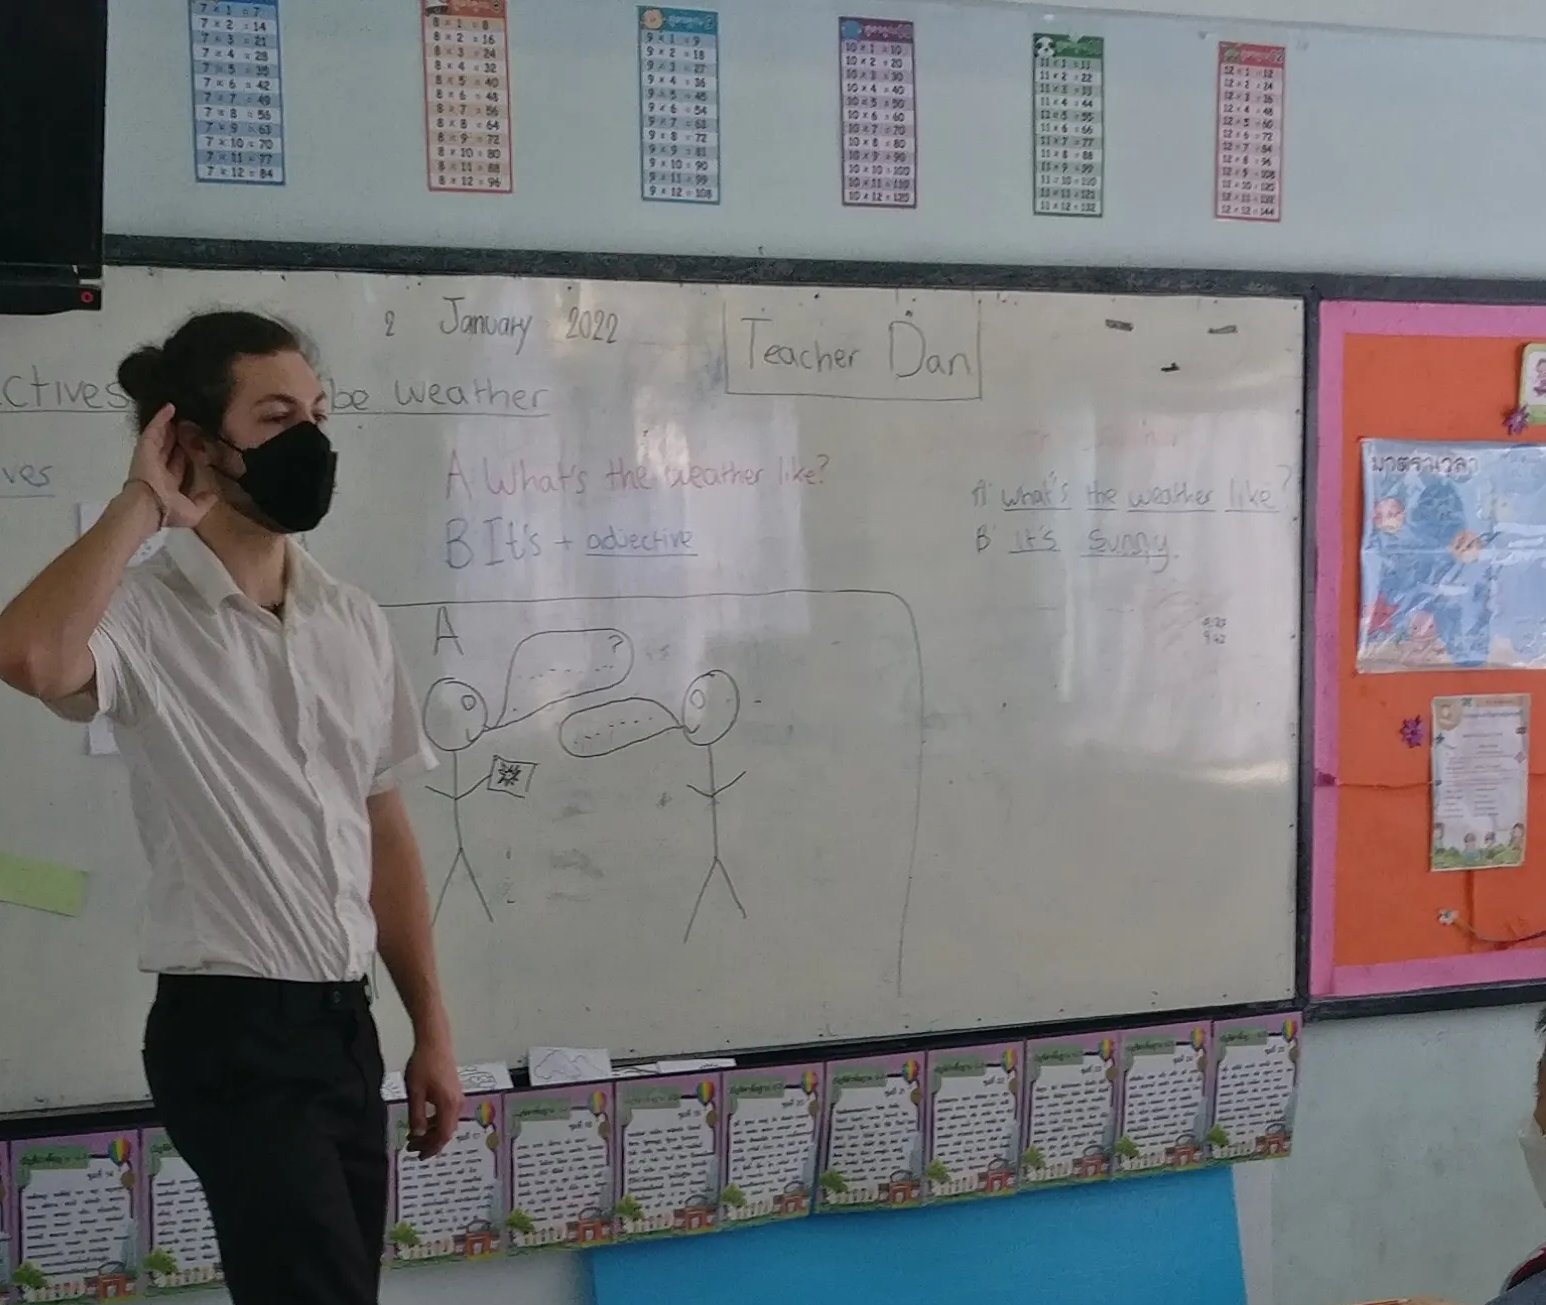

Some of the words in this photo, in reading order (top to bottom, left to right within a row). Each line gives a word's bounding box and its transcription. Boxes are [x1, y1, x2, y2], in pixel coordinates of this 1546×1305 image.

[439, 296, 533, 356] January
[565, 305, 620, 344] 2022
[741, 316, 862, 371] Teacher
[888, 318, 972, 379] Dan
[394, 378, 548, 411] weather
[482, 456, 588, 496] What's
[605, 456, 652, 491] the
[663, 460, 765, 489] weather
[778, 453, 831, 486] like?
[1085, 476, 1117, 505] the
[482, 516, 543, 567] It's
[433, 605, 465, 656] A
